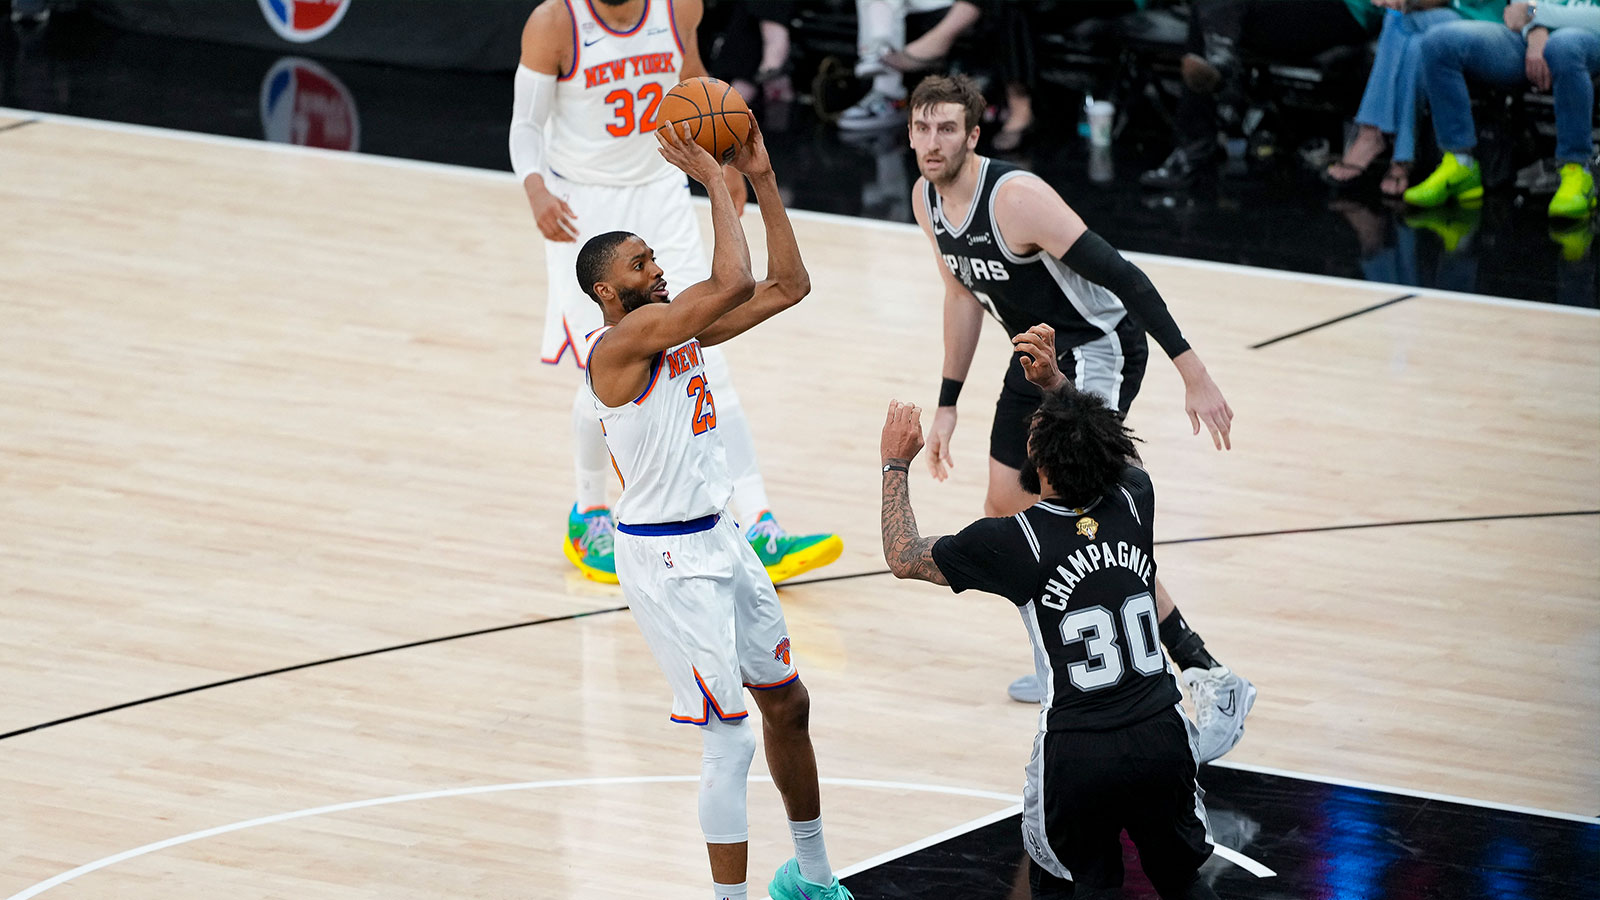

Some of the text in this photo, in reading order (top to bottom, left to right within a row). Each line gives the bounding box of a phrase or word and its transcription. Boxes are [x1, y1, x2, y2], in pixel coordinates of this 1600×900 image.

[583, 52, 676, 90] NEW YORK
[604, 82, 663, 138] 32
[665, 341, 699, 380] NEW
[1041, 540, 1152, 612] CHAMPAGNIE
[1058, 591, 1165, 693] 30
